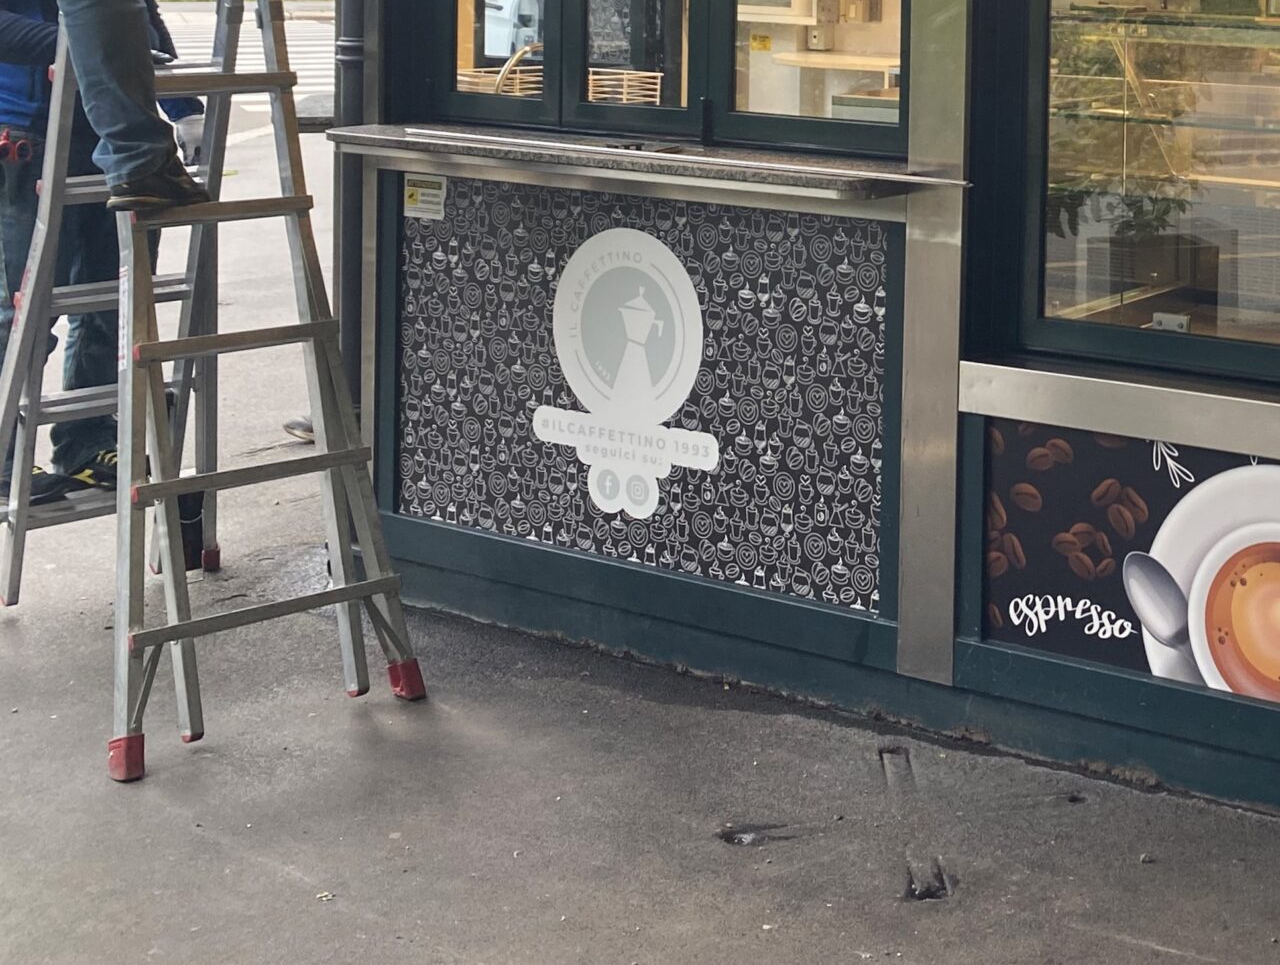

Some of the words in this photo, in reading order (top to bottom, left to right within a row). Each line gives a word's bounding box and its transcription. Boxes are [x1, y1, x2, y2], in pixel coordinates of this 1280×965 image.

[570, 250, 643, 313] CAFFETTINO
[541, 417, 667, 450] #ILCAFFETTINO
[673, 440, 710, 458] 1993
[585, 443, 636, 464] seguici
[642, 455, 664, 467] su:
[1008, 593, 1139, 639] espresso
